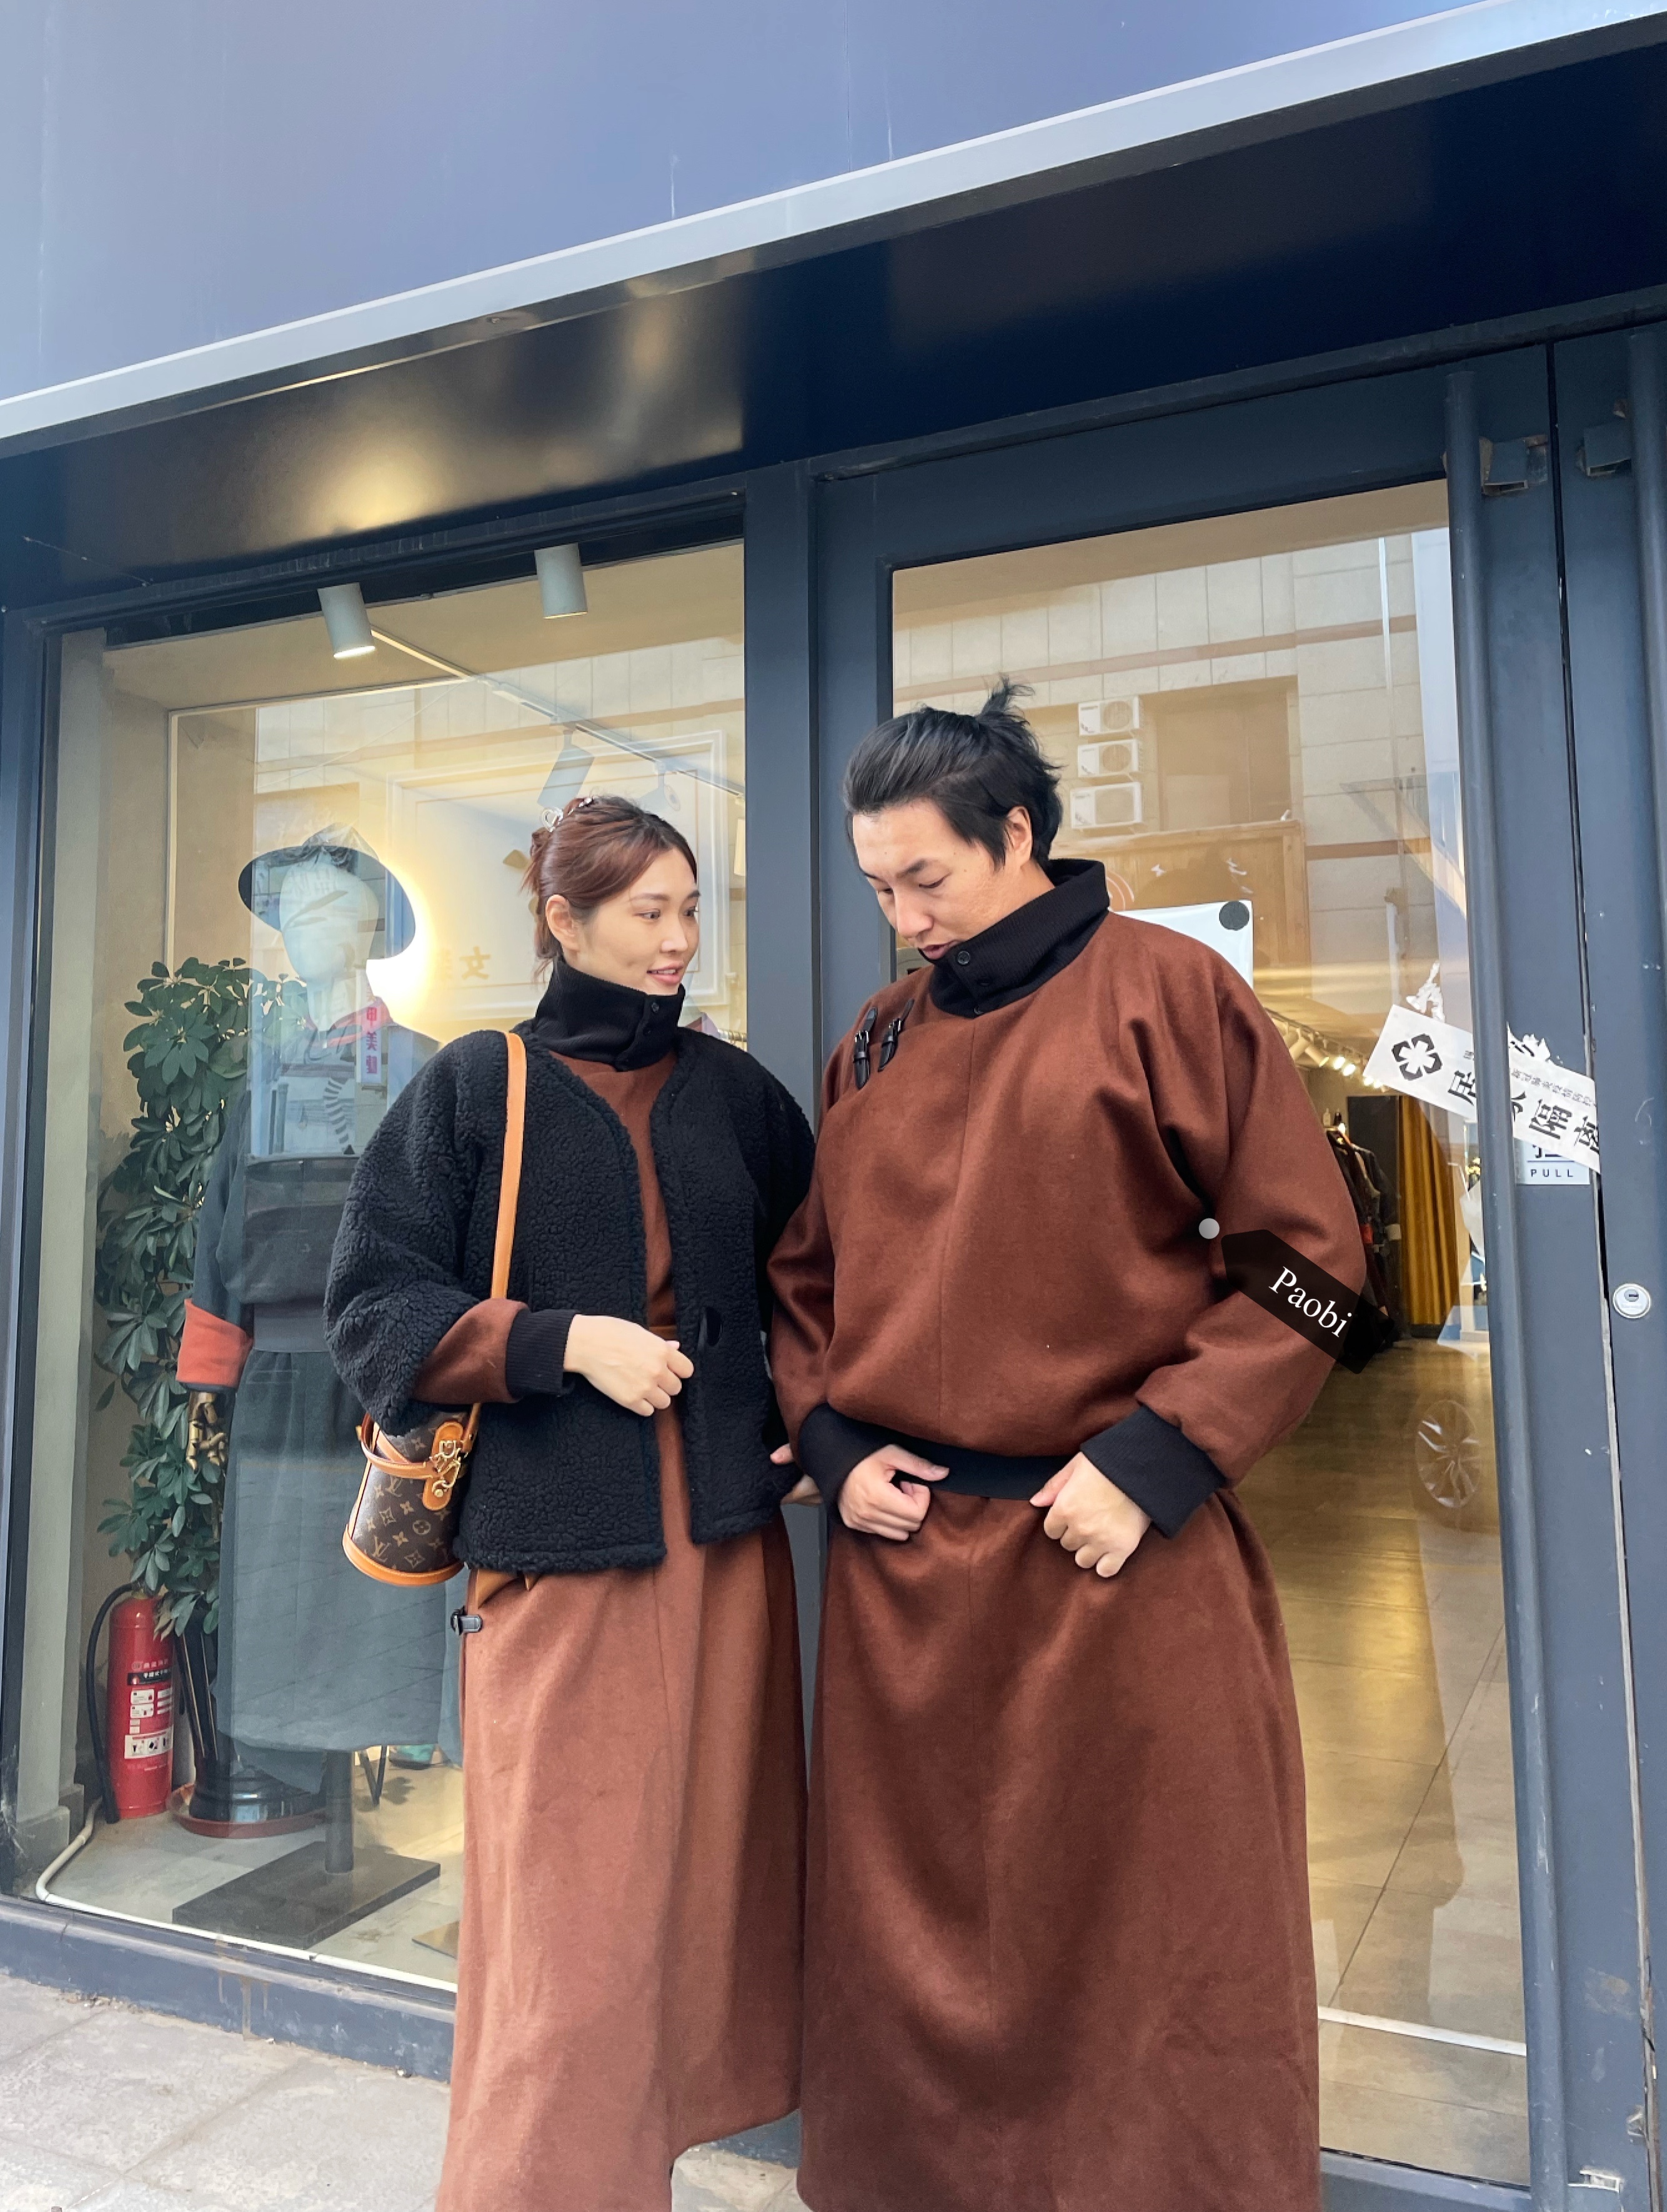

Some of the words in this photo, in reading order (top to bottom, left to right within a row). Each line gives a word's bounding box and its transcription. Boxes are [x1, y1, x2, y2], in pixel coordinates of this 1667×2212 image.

[1448, 1070, 1599, 1153] 居隔离
[1531, 1169, 1573, 1177] PULL
